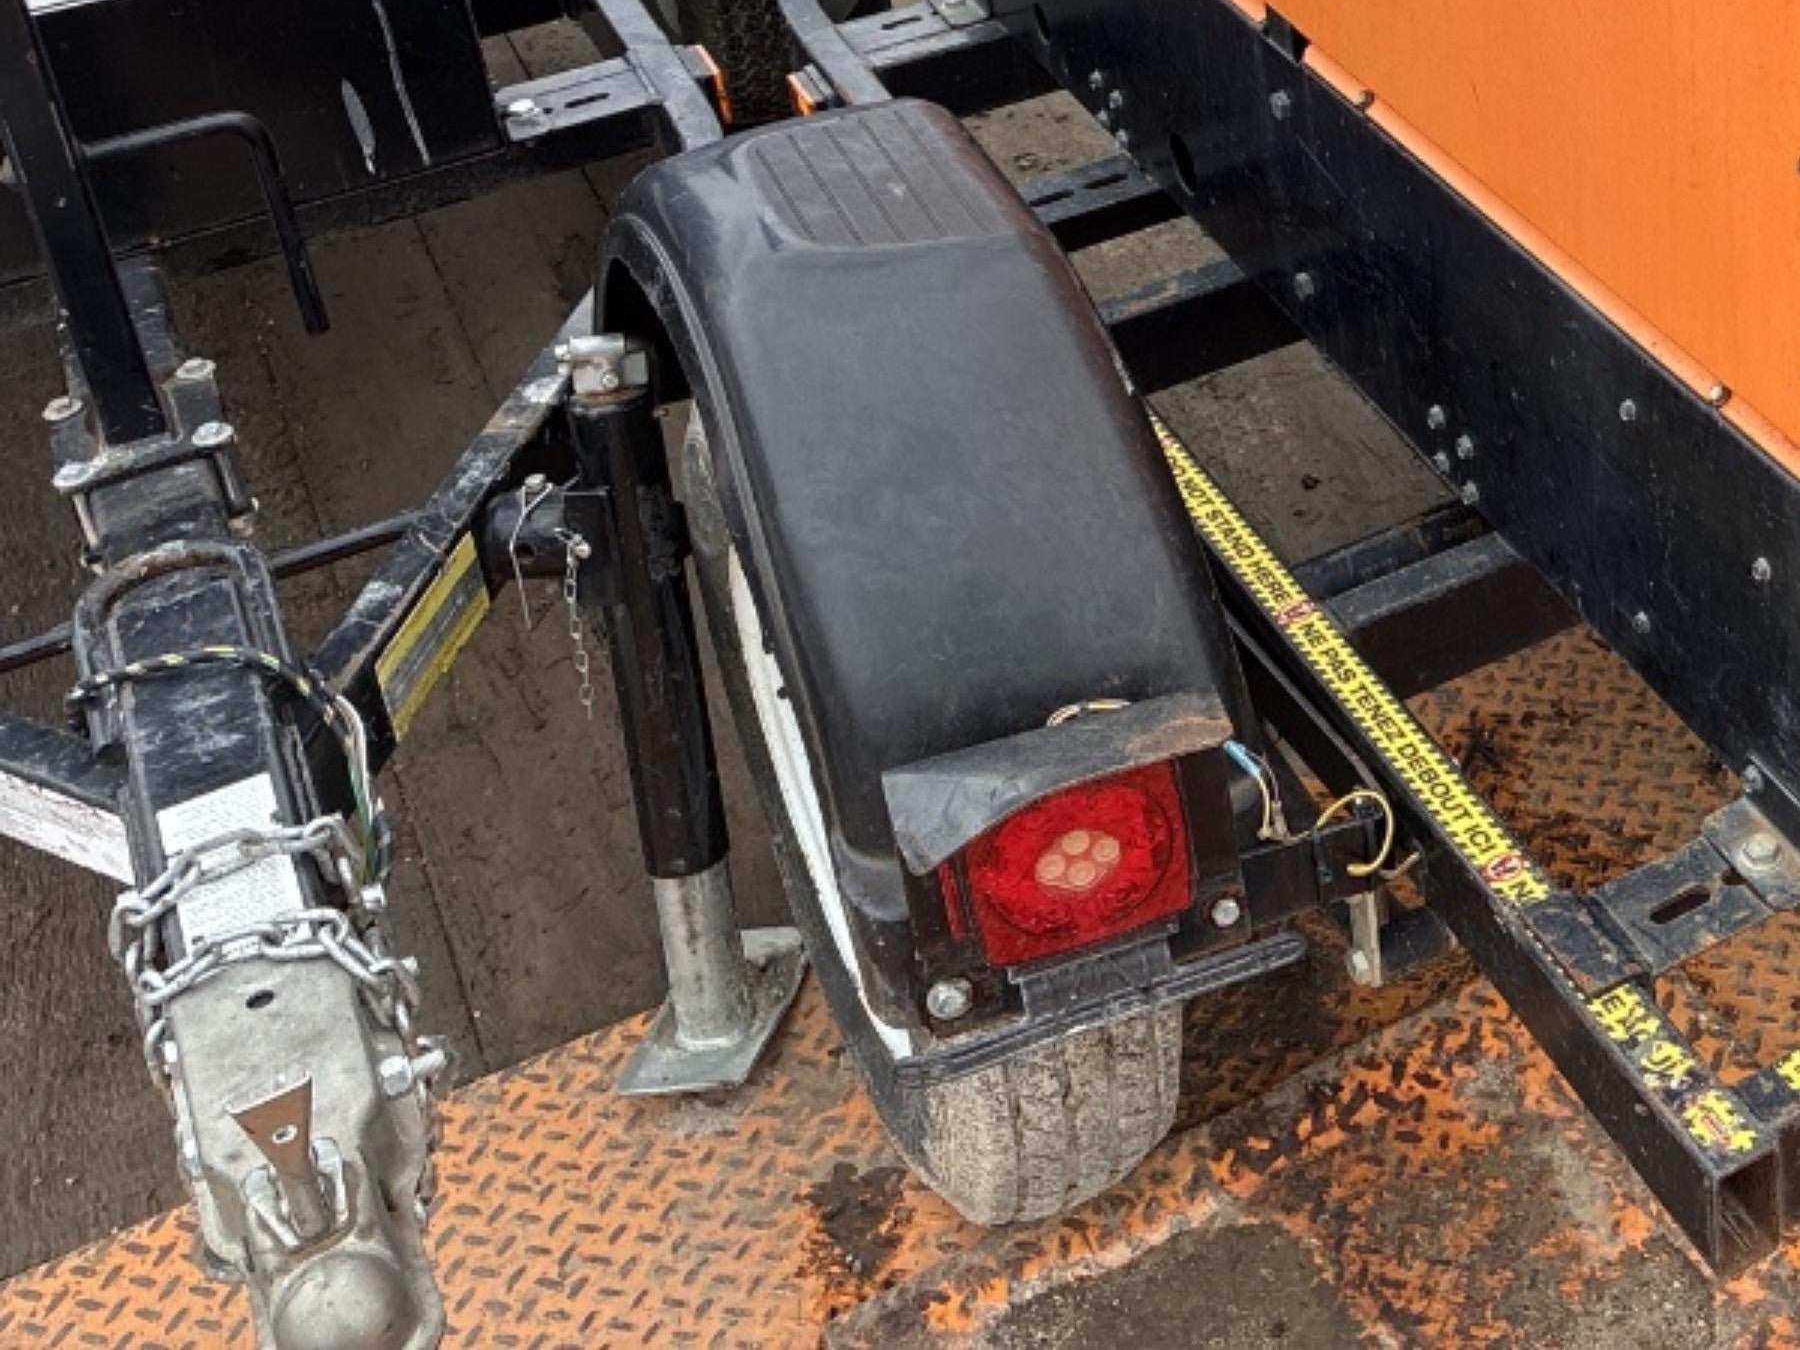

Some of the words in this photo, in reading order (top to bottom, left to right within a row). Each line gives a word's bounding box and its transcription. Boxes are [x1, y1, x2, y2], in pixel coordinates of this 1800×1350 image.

[1183, 476, 1215, 507] NOT
[1205, 508, 1256, 560] STAND
[1246, 560, 1294, 605] HERE
[1301, 622, 1328, 648] NE
[1321, 648, 1358, 685] PAS
[1351, 681, 1406, 744] TENEZ
[1399, 742, 1475, 825] DEBOUT
[1463, 825, 1497, 855] ICI
